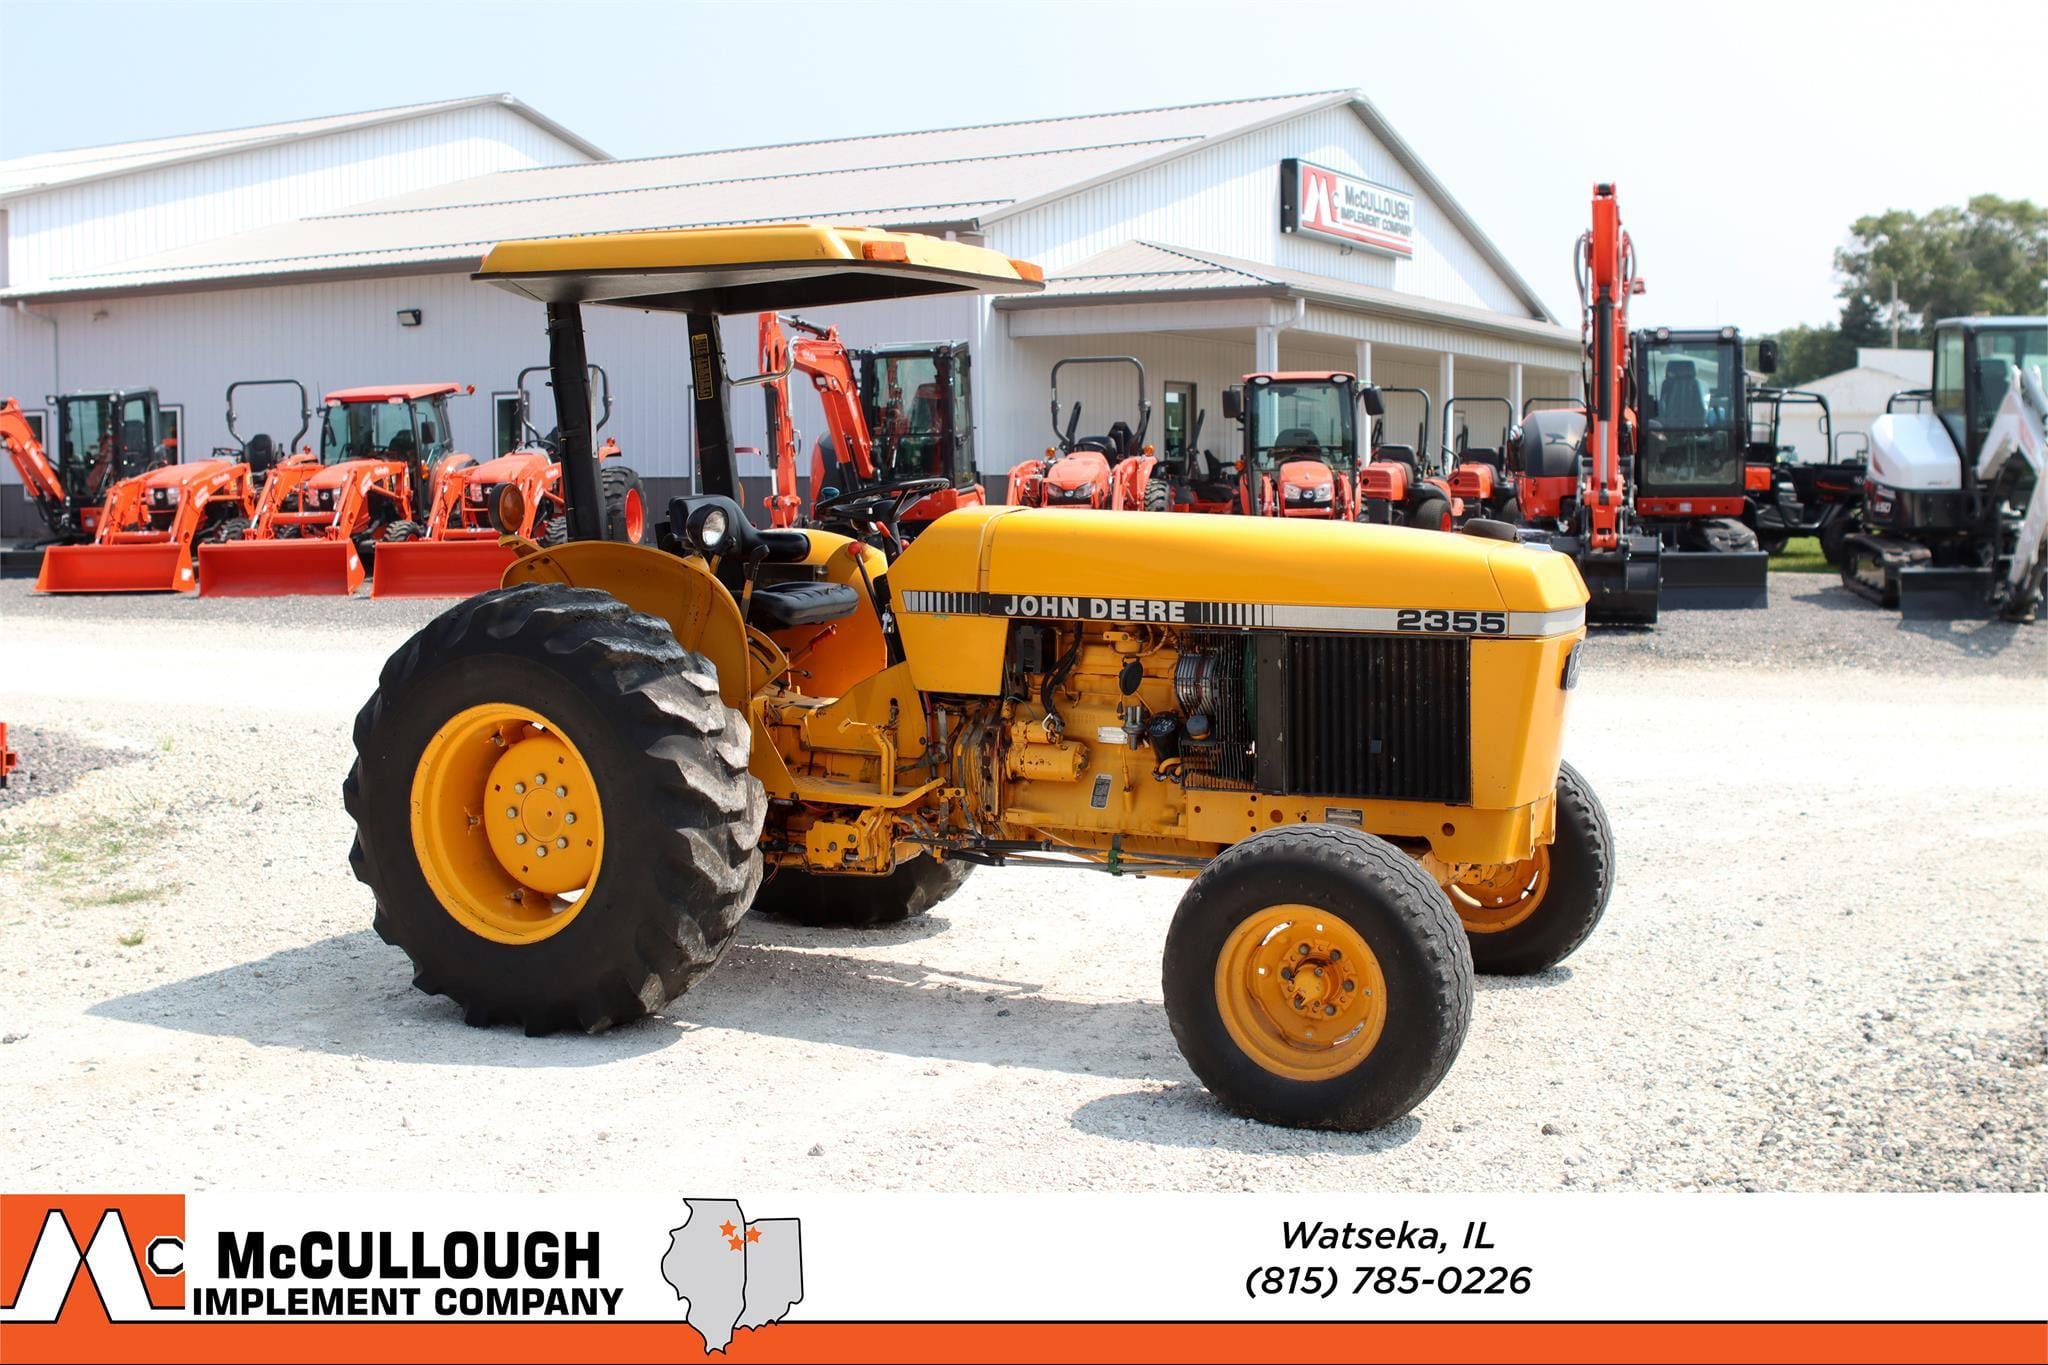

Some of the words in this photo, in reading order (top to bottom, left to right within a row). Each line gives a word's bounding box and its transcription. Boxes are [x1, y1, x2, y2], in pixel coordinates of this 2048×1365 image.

[1340, 207, 1381, 228] IMPLEMENT
[1382, 218, 1413, 235] COMPANY
[1004, 596, 1079, 618] JOHN
[1089, 598, 1186, 623] DEERE
[1397, 609, 1505, 633] 2355
